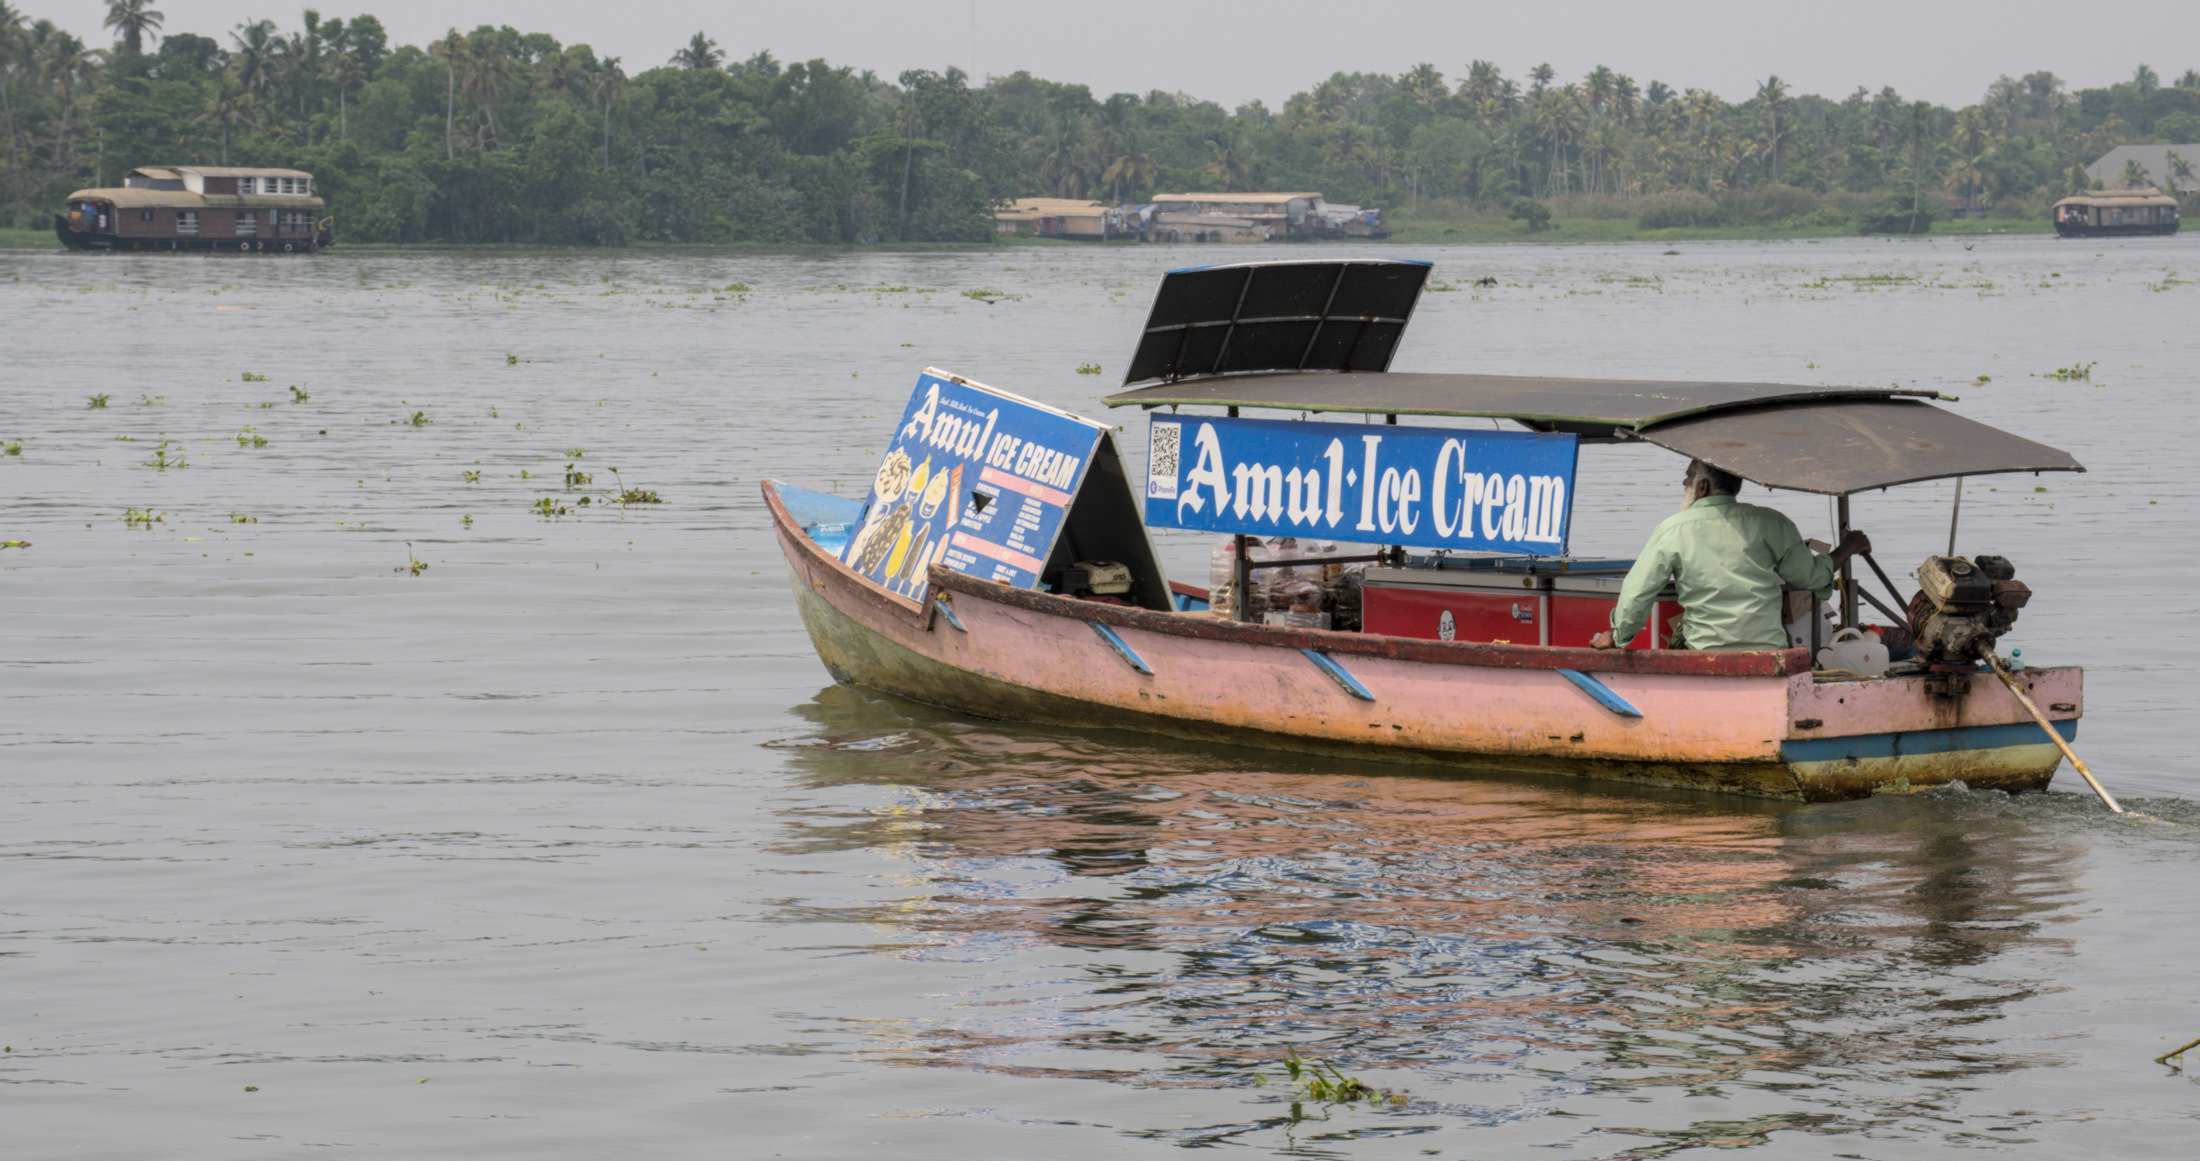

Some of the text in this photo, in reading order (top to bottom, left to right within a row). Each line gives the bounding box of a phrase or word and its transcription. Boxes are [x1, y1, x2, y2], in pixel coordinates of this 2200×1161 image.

[899, 383, 998, 462] Amul
[985, 432, 1021, 471] ICE
[1014, 442, 1080, 490] CREAM
[1355, 435, 1421, 536] Ice
[1432, 438, 1565, 544] Cream
